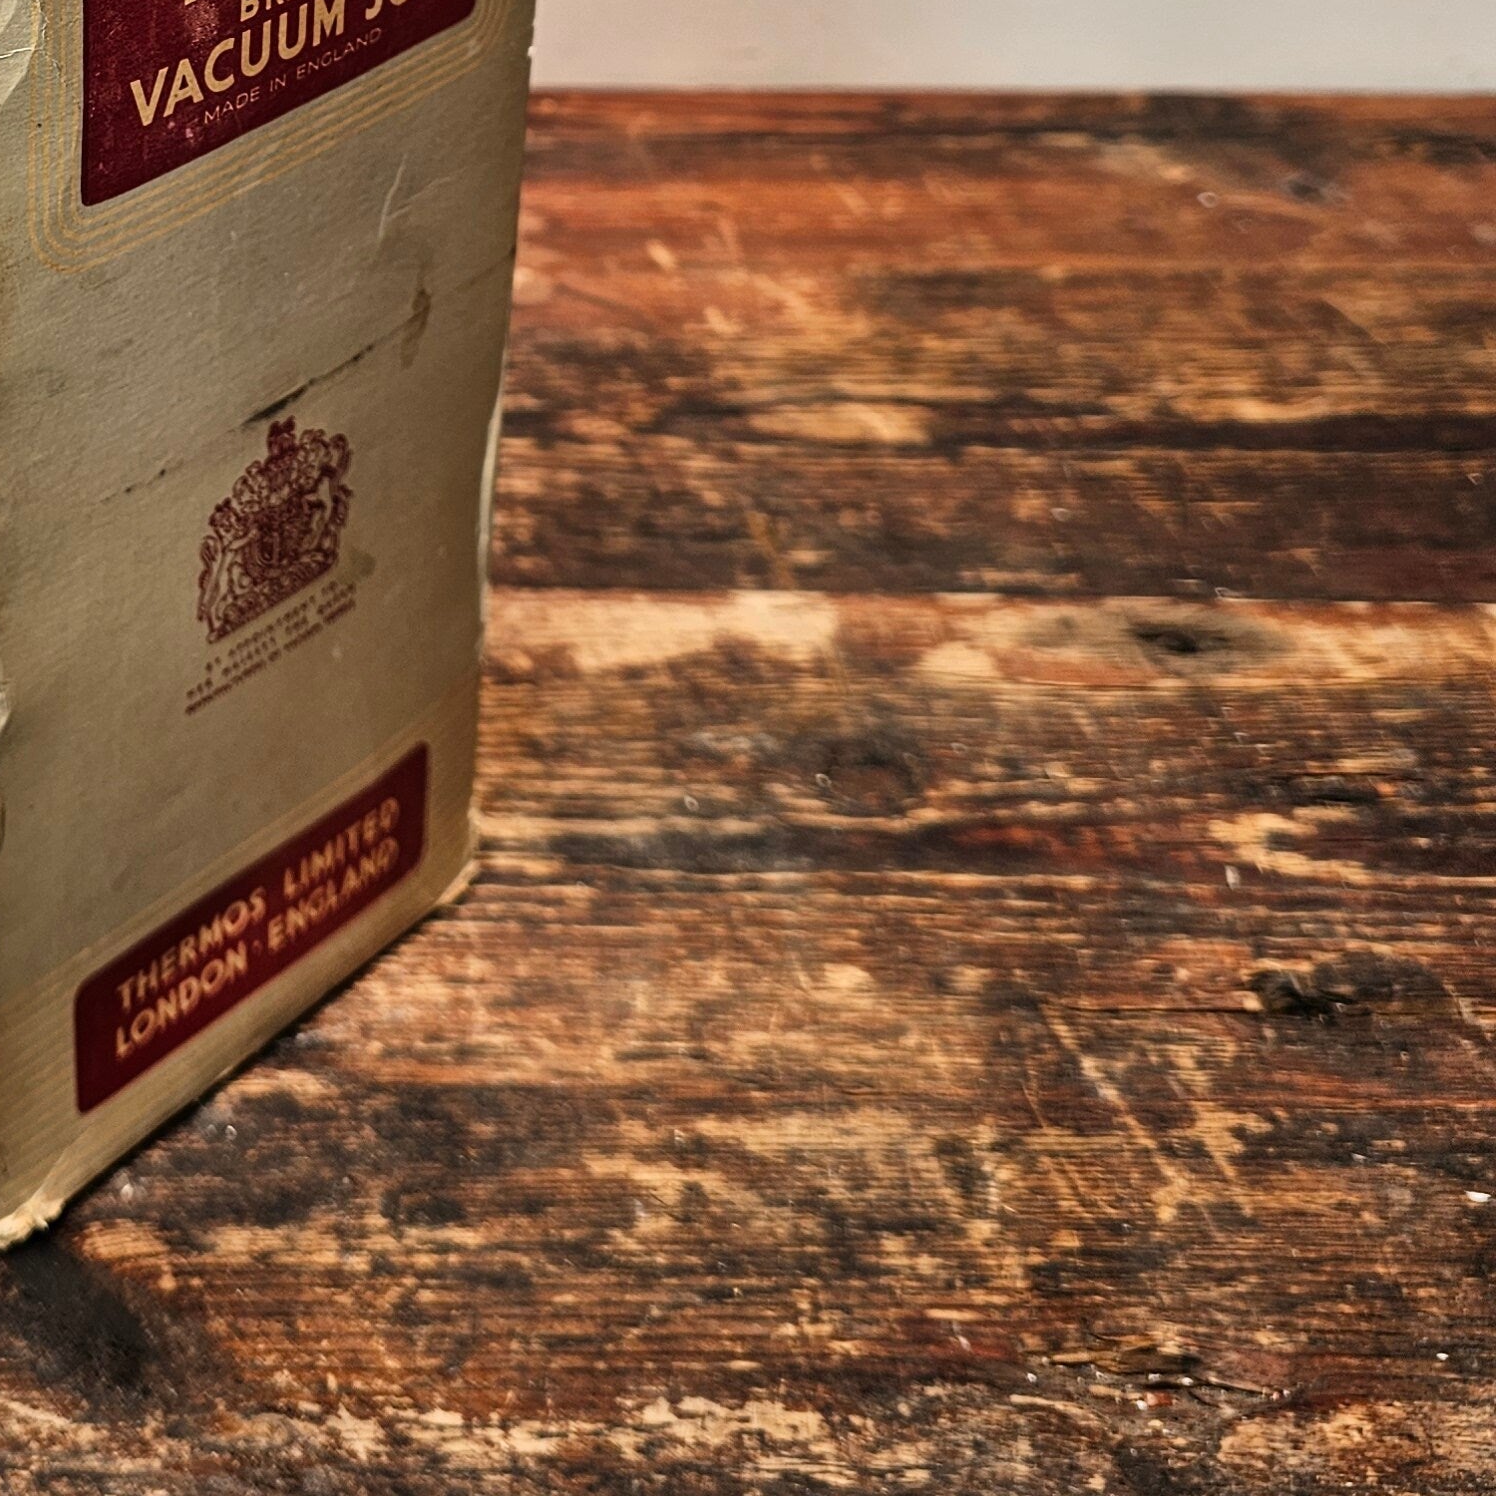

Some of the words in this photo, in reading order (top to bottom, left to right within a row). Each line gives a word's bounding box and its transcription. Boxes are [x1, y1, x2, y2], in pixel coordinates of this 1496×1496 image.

[204, 88, 261, 124] MADE
[269, 71, 287, 96] IN
[296, 26, 382, 80] ENGLAND
[113, 941, 249, 1061] LONDON
[266, 835, 400, 952] ENGLAND
[115, 886, 267, 1012] THERMOS
[282, 796, 401, 895] LIMITED
